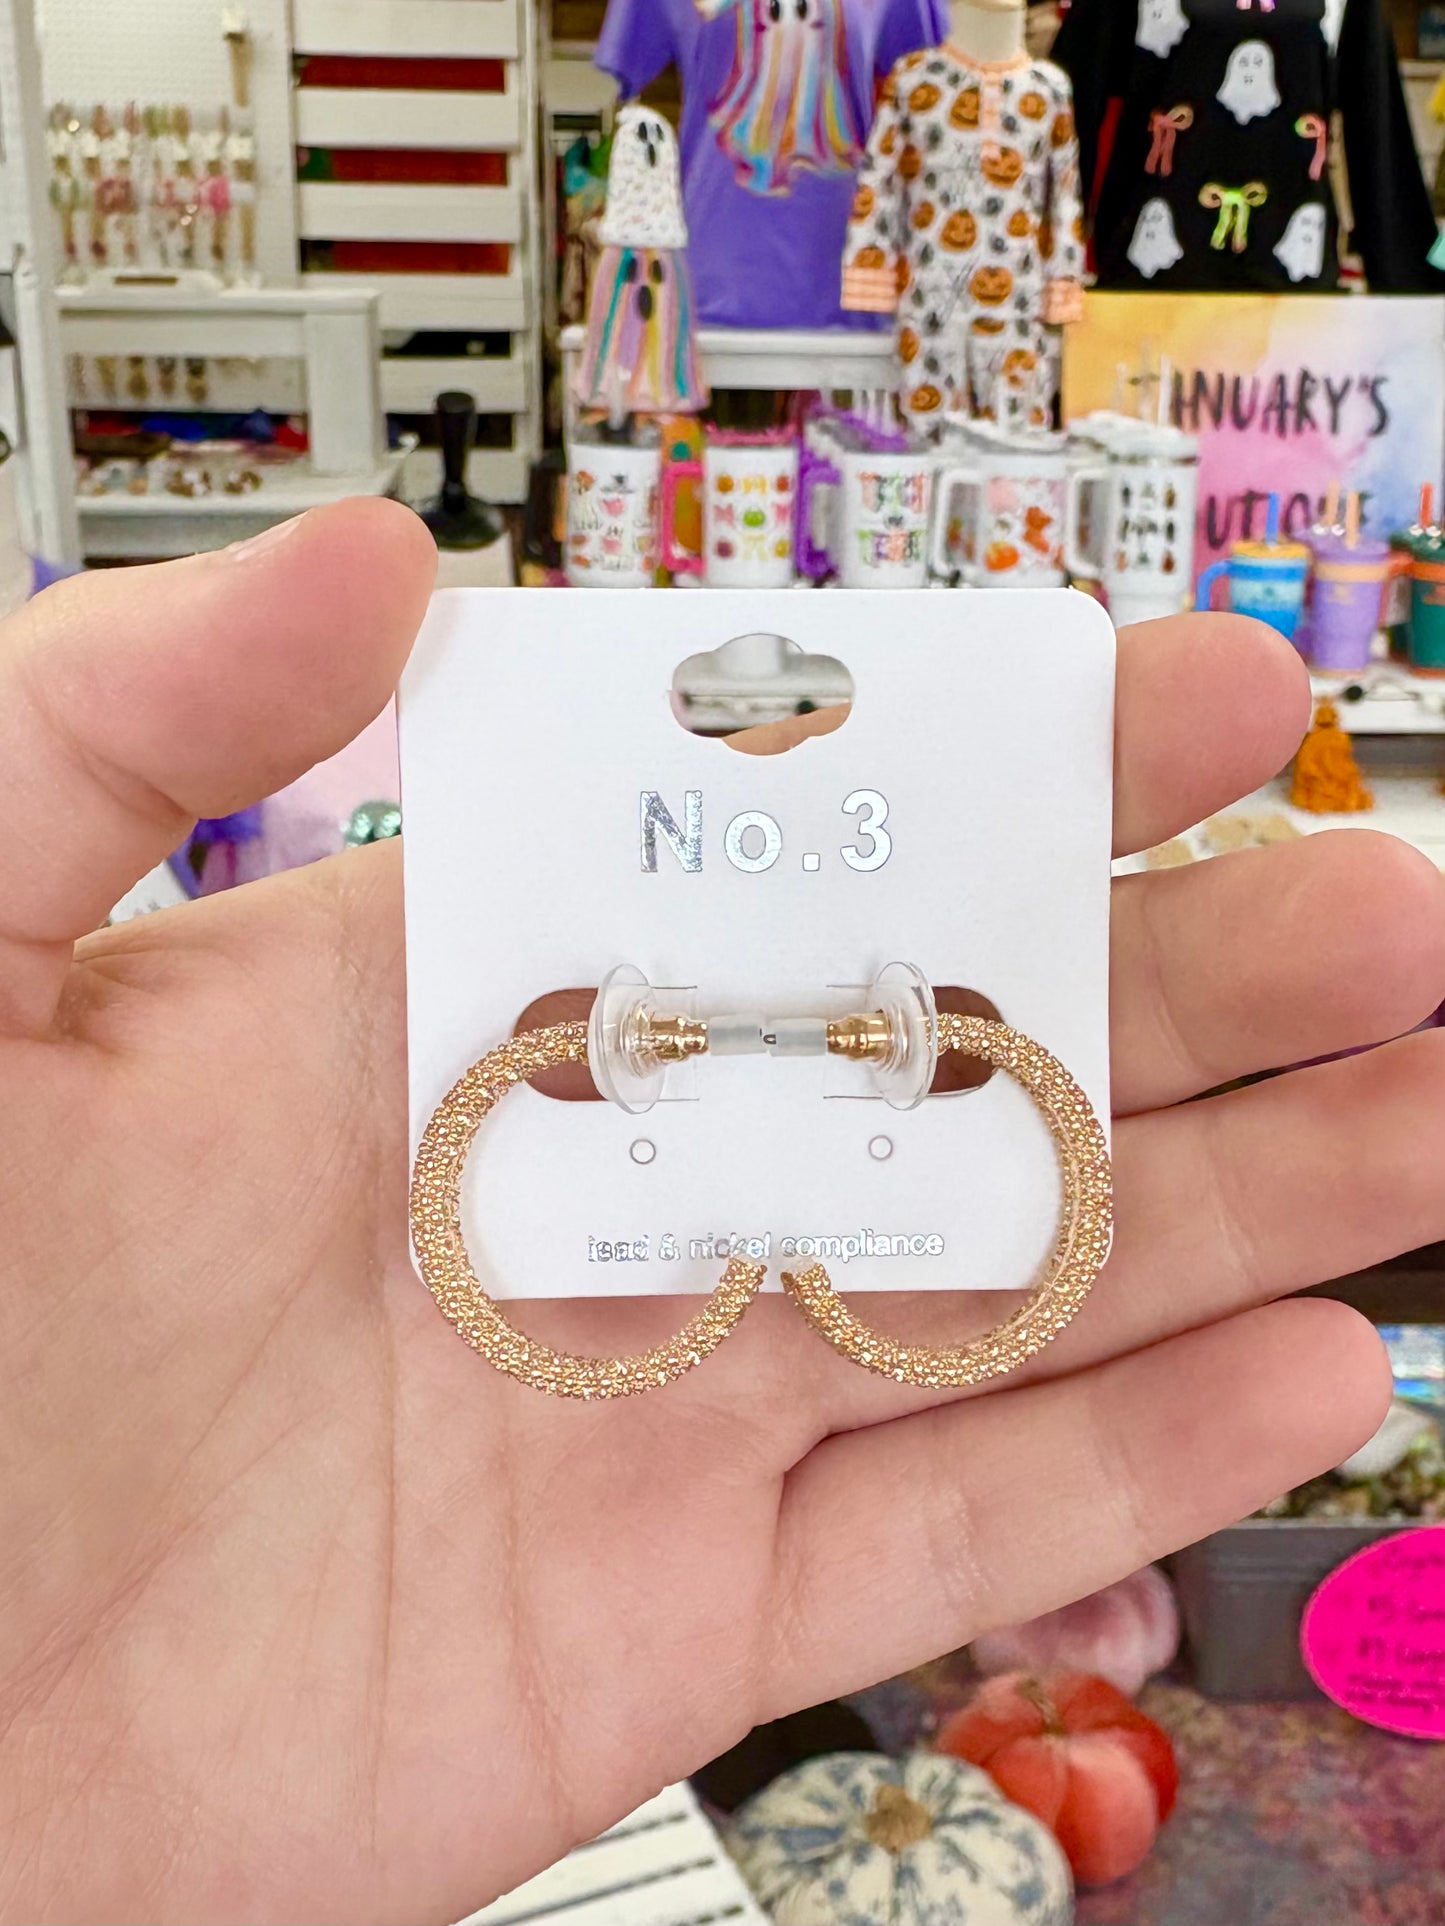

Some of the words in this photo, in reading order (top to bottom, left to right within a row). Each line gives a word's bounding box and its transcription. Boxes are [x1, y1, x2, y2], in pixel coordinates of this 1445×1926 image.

[587, 1234, 650, 1262] lead
[658, 1233, 681, 1261] &
[689, 1231, 772, 1260] nickel
[780, 1229, 945, 1262] compliance
